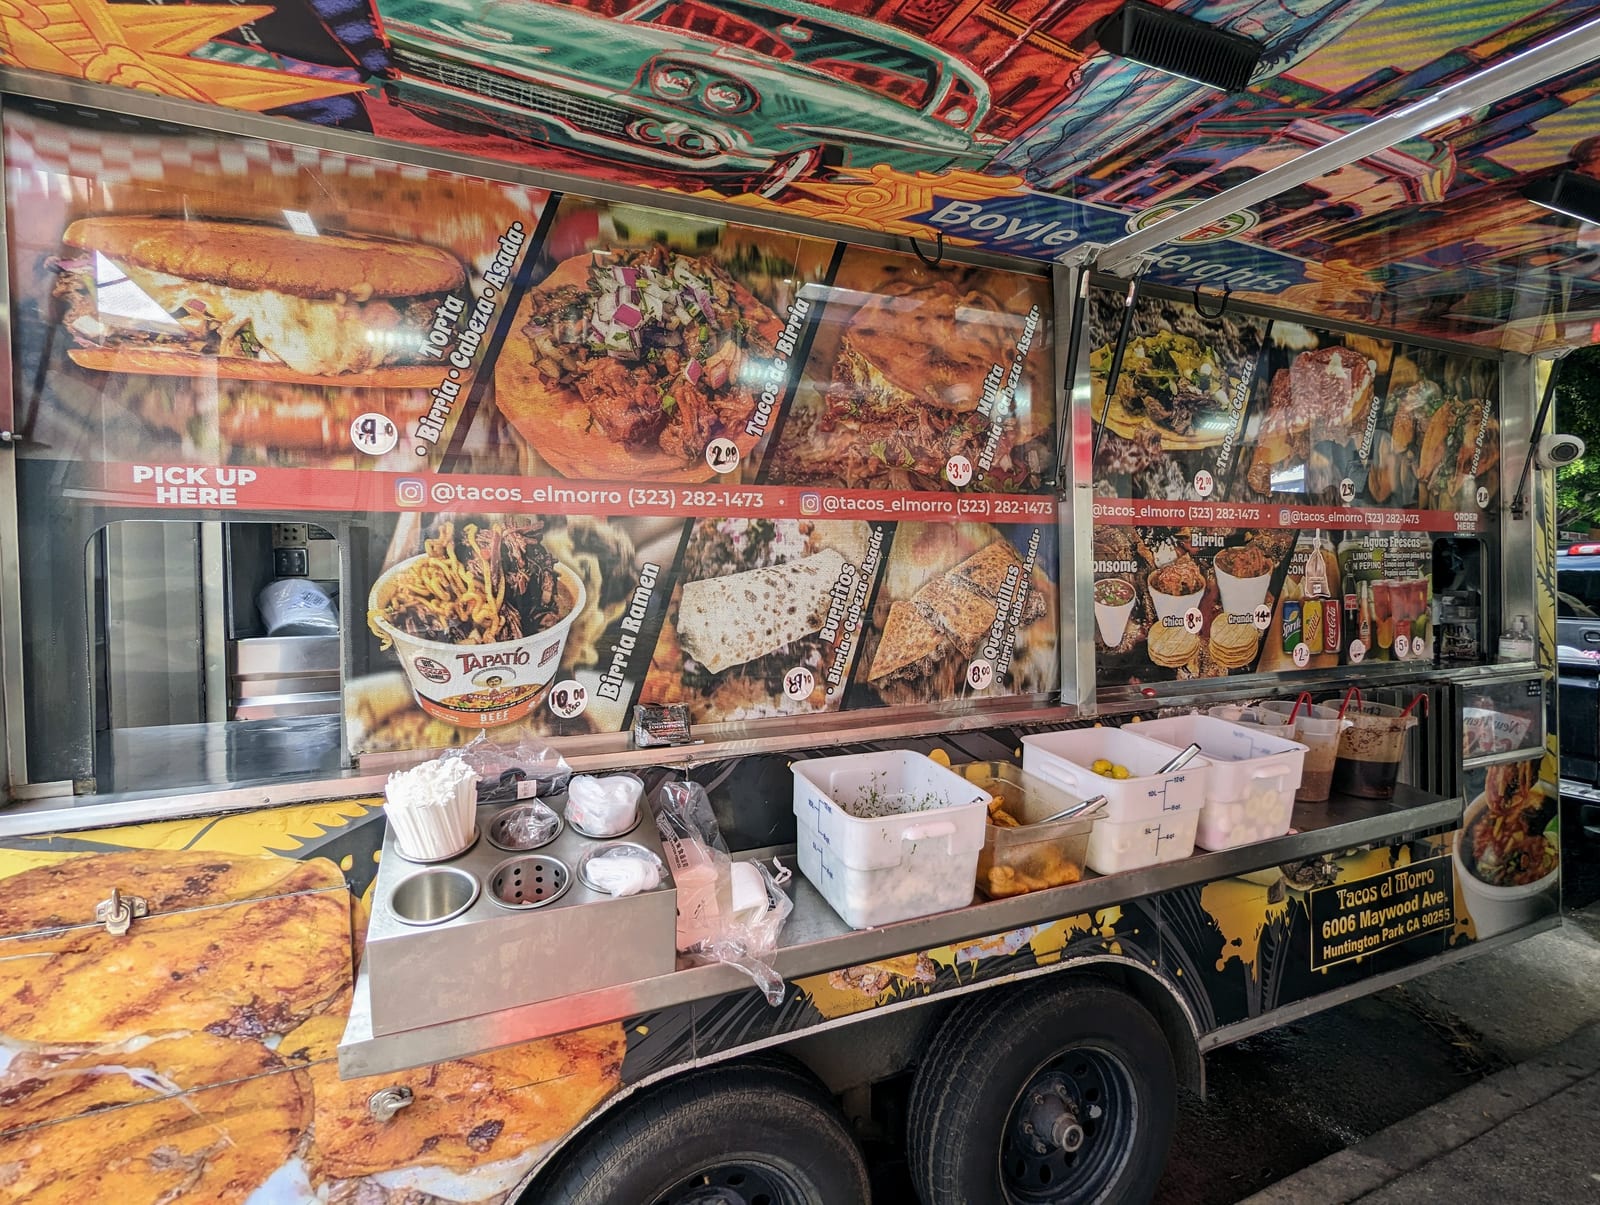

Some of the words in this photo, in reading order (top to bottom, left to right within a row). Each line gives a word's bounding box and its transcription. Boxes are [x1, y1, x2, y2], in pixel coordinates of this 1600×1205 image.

[928, 200, 1079, 246] Boyle
[415, 375, 461, 445] Birria
[450, 297, 496, 370] Cabeza
[484, 226, 525, 291] Asada
[418, 294, 465, 358] Torta
[745, 381, 779, 437] Tacos
[776, 298, 811, 357] Birria
[977, 363, 1004, 417] Mulita
[978, 422, 1003, 472] Birria
[997, 362, 1024, 418] Cabeza
[1016, 308, 1040, 357] Asada
[1216, 426, 1237, 470] Tacos
[1233, 359, 1255, 412] Cabeza
[1358, 396, 1381, 461] Quesataco
[133, 466, 208, 485] PICK
[216, 469, 257, 486] UP
[156, 486, 237, 505] HERE
[430, 482, 622, 505] @tacos_elmorro
[628, 487, 676, 509] (323)
[681, 490, 764, 508] 282-1473
[823, 494, 952, 513] @tacos_elmorro
[956, 499, 991, 516] (323)
[994, 500, 1053, 515] 282-1473
[1093, 503, 1185, 519] @tacos_elmorro
[1188, 506, 1213, 521] (323)
[1216, 508, 1260, 520] 282-1473
[1291, 511, 1363, 524] @tacos_elmorro
[1364, 513, 1384, 526] (323)
[1385, 513, 1420, 525] 282-1473
[1454, 513, 1478, 522] ORDER
[1457, 521, 1476, 531] HERE
[1191, 534, 1225, 547] Birria
[1362, 535, 1388, 551] Aguas
[1389, 537, 1421, 548] Frescas
[1093, 560, 1138, 573] onsome
[1287, 565, 1304, 575] CON
[1352, 553, 1373, 561] LIMON
[1359, 562, 1381, 570] PEPINO
[819, 562, 856, 643] Burritos
[829, 638, 851, 687] Birria
[844, 578, 869, 632] Cabeza
[861, 530, 883, 575] Asada
[983, 564, 1019, 661] Quesadillas
[996, 633, 1016, 676] Birria
[1009, 577, 1029, 627] Cabeza
[1022, 531, 1041, 574] Asada
[598, 633, 637, 701] Birria
[621, 562, 660, 634] Ramen
[1162, 616, 1184, 627] Chica
[1228, 614, 1253, 624] Grande
[480, 710, 508, 722] BEEF
[1336, 885, 1378, 910] Tacos
[1380, 877, 1393, 898] el
[1395, 868, 1435, 894] Morro
[1322, 914, 1357, 939] 6006
[1359, 894, 1419, 929] Maywood
[1422, 890, 1449, 908] Ave.
[1323, 932, 1380, 960] Huntington
[1382, 924, 1405, 942] Park
[1406, 917, 1420, 933] CA
[1422, 908, 1450, 929] 90255
